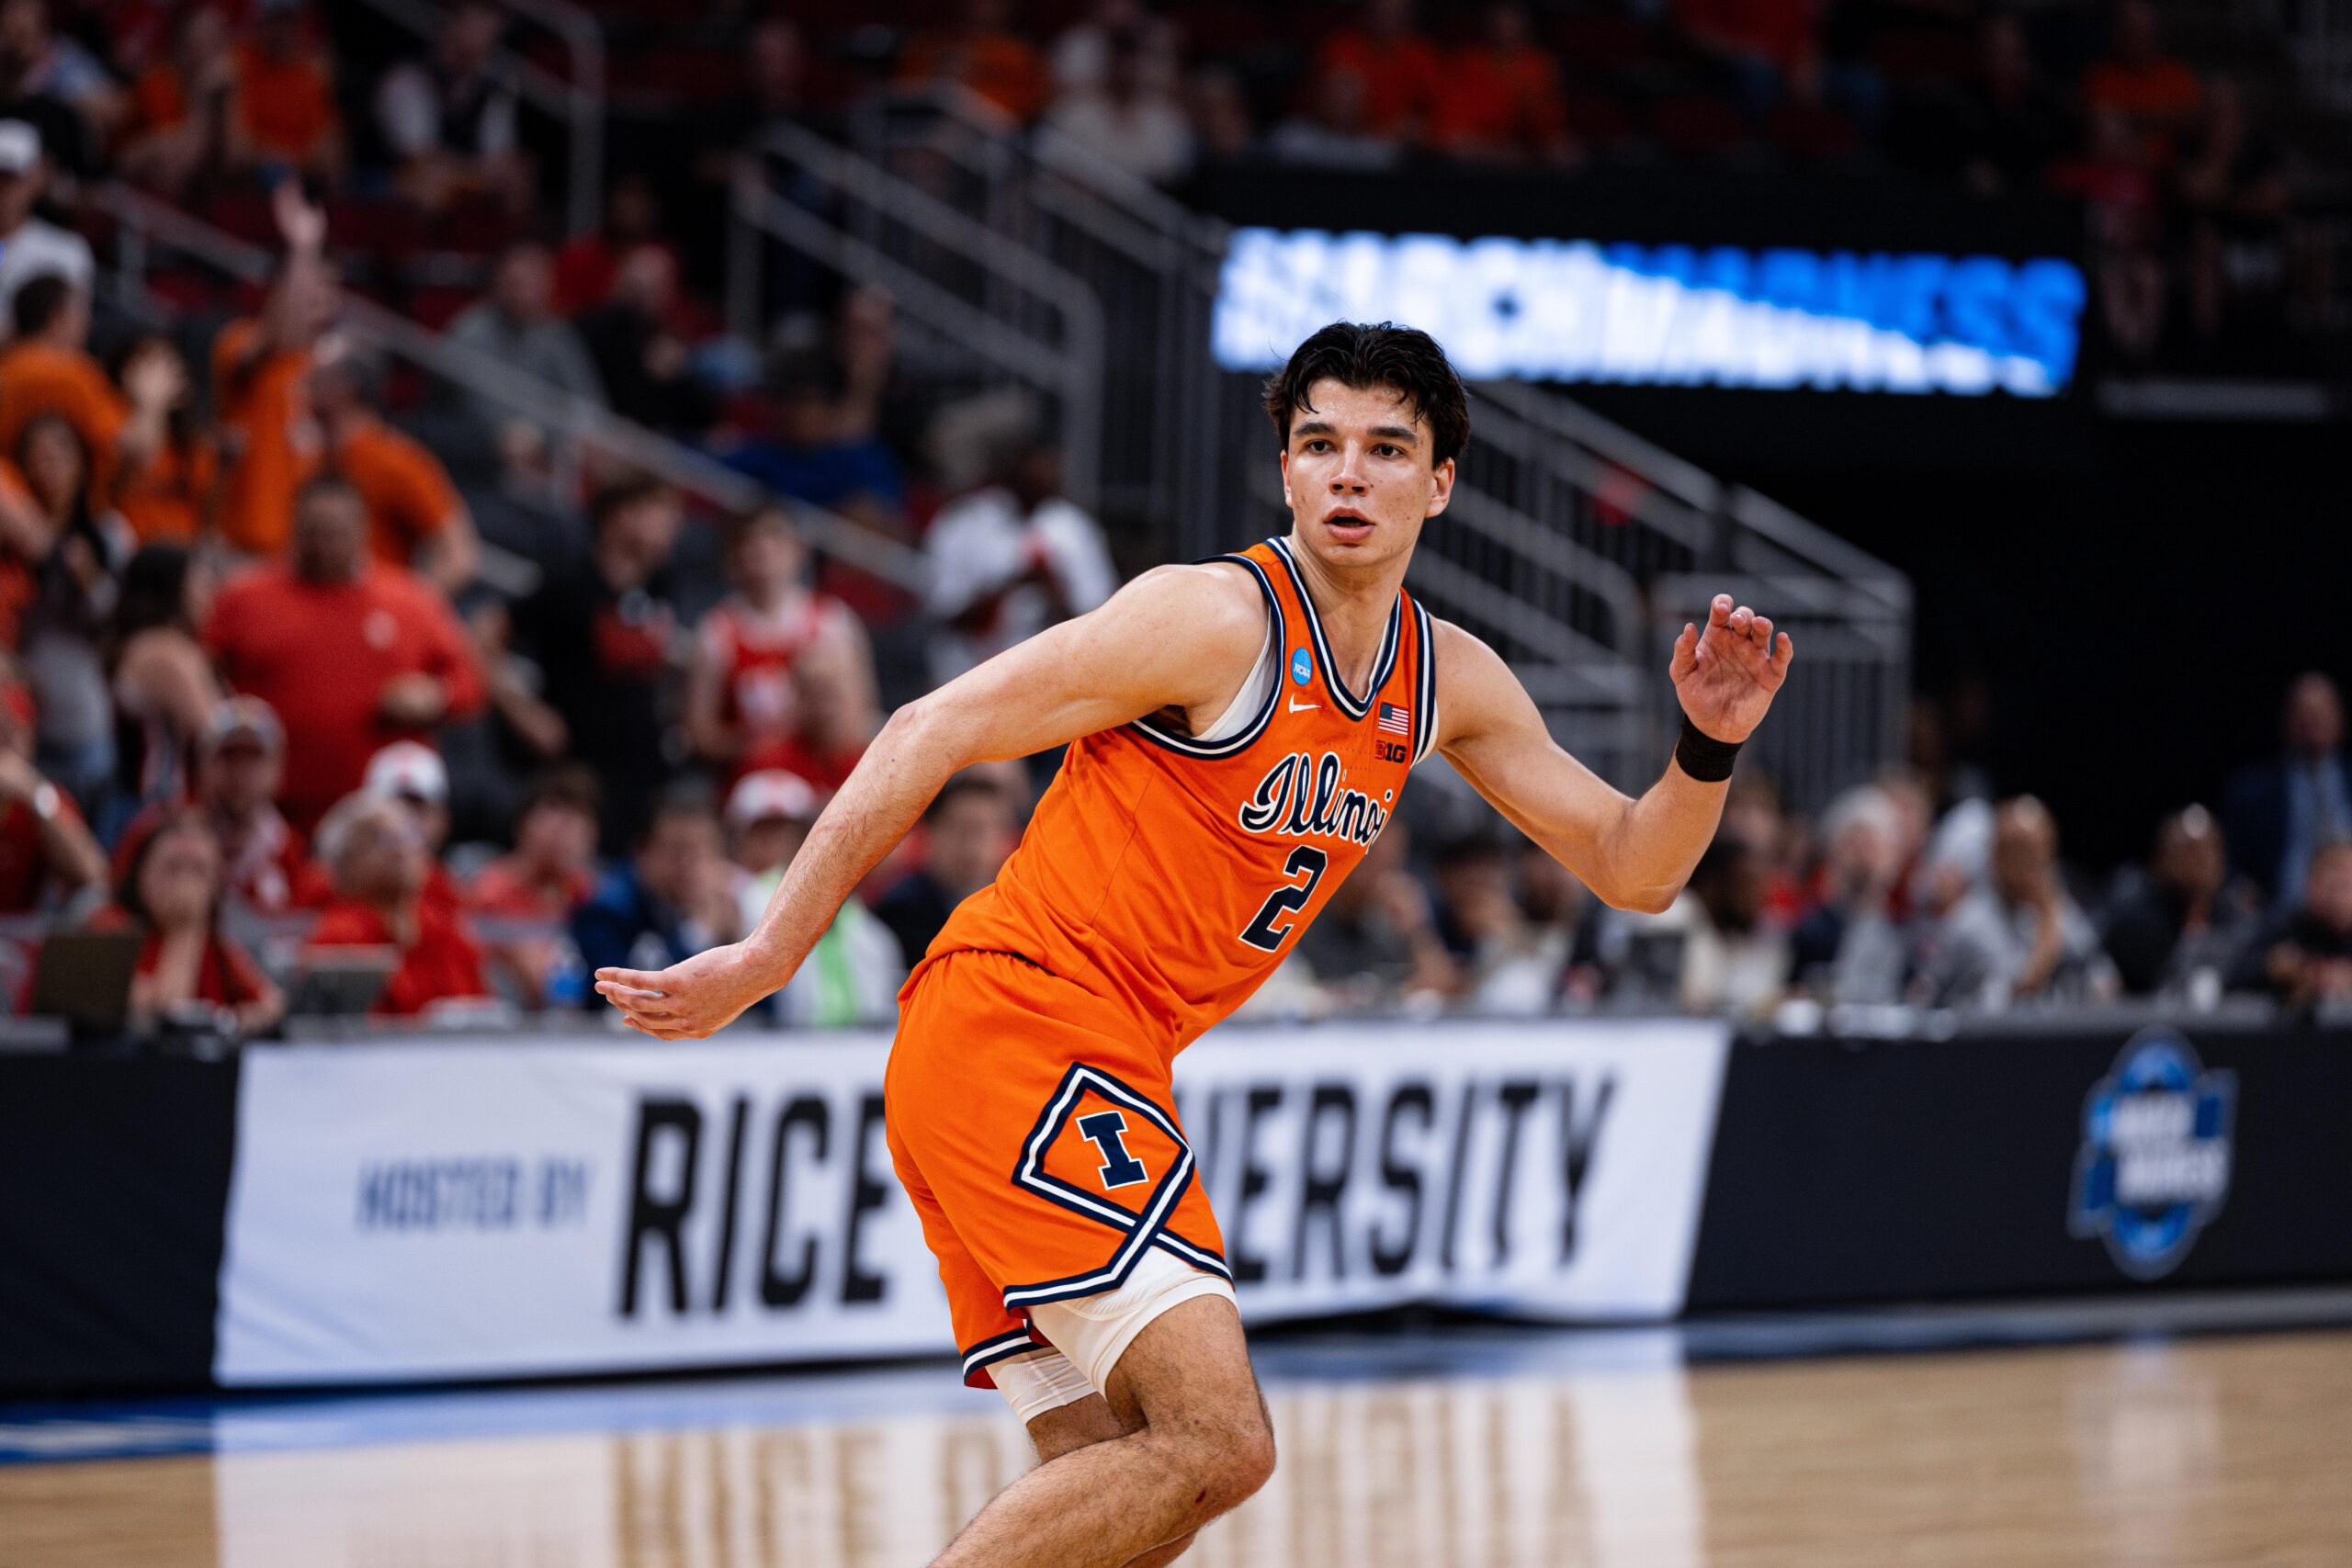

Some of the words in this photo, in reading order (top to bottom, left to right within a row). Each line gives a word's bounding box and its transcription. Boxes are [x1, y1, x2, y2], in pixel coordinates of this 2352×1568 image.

[1240, 751, 1393, 853] Illinoi
[1238, 845, 1328, 953] 2
[1076, 1111, 1148, 1190] I
[357, 1159, 521, 1233] HOSTED
[540, 1159, 589, 1231] BY
[622, 1093, 889, 1317] RICE
